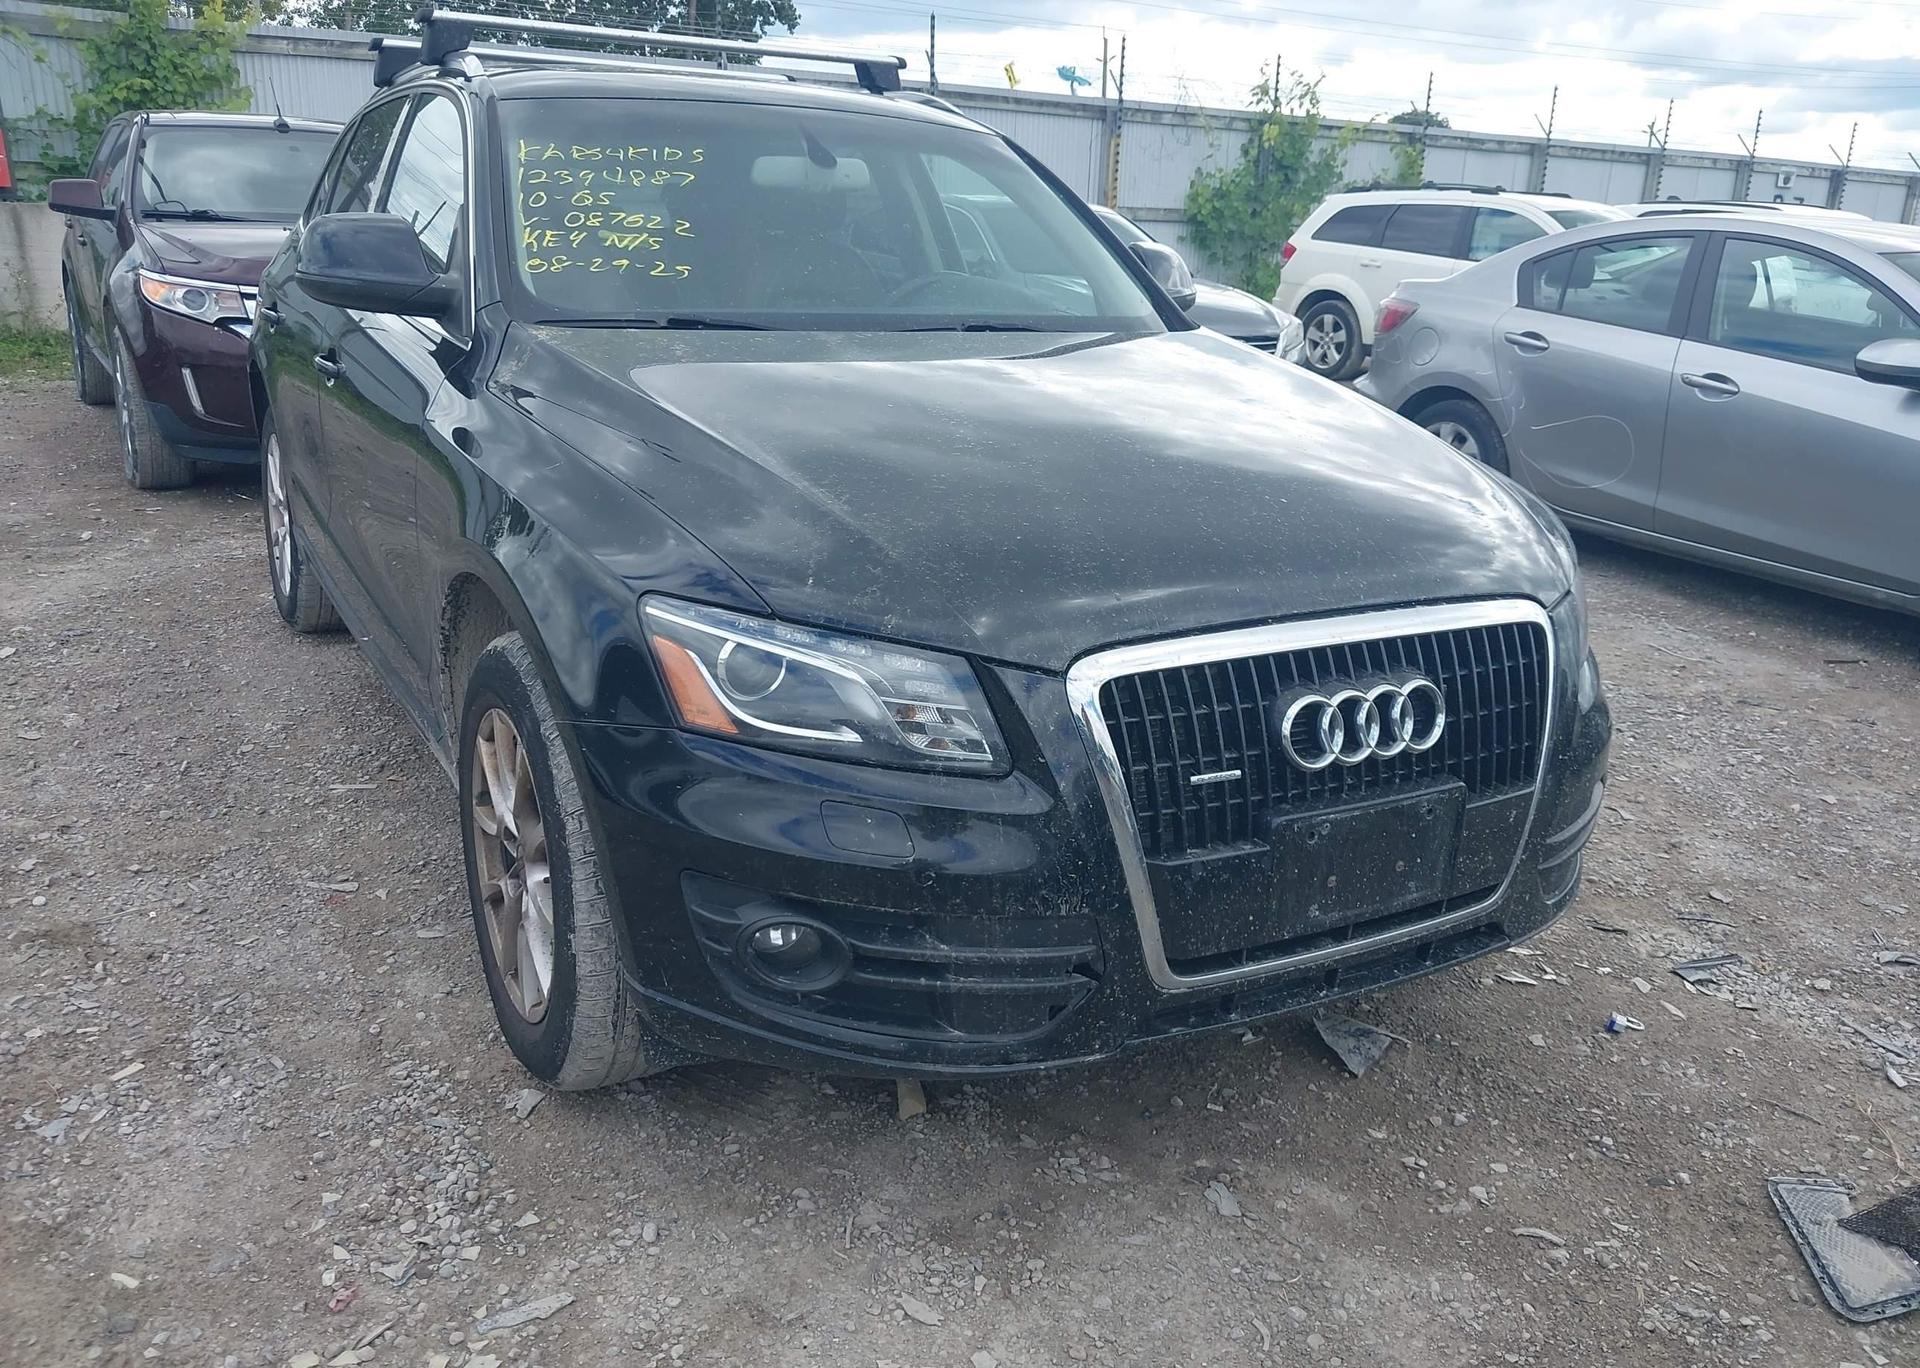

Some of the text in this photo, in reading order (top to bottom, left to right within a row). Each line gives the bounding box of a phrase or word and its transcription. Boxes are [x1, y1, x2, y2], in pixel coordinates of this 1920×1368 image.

[518, 167, 696, 187] 12394887
[522, 227, 588, 252] KEY
[524, 255, 693, 280] 08-29-25
